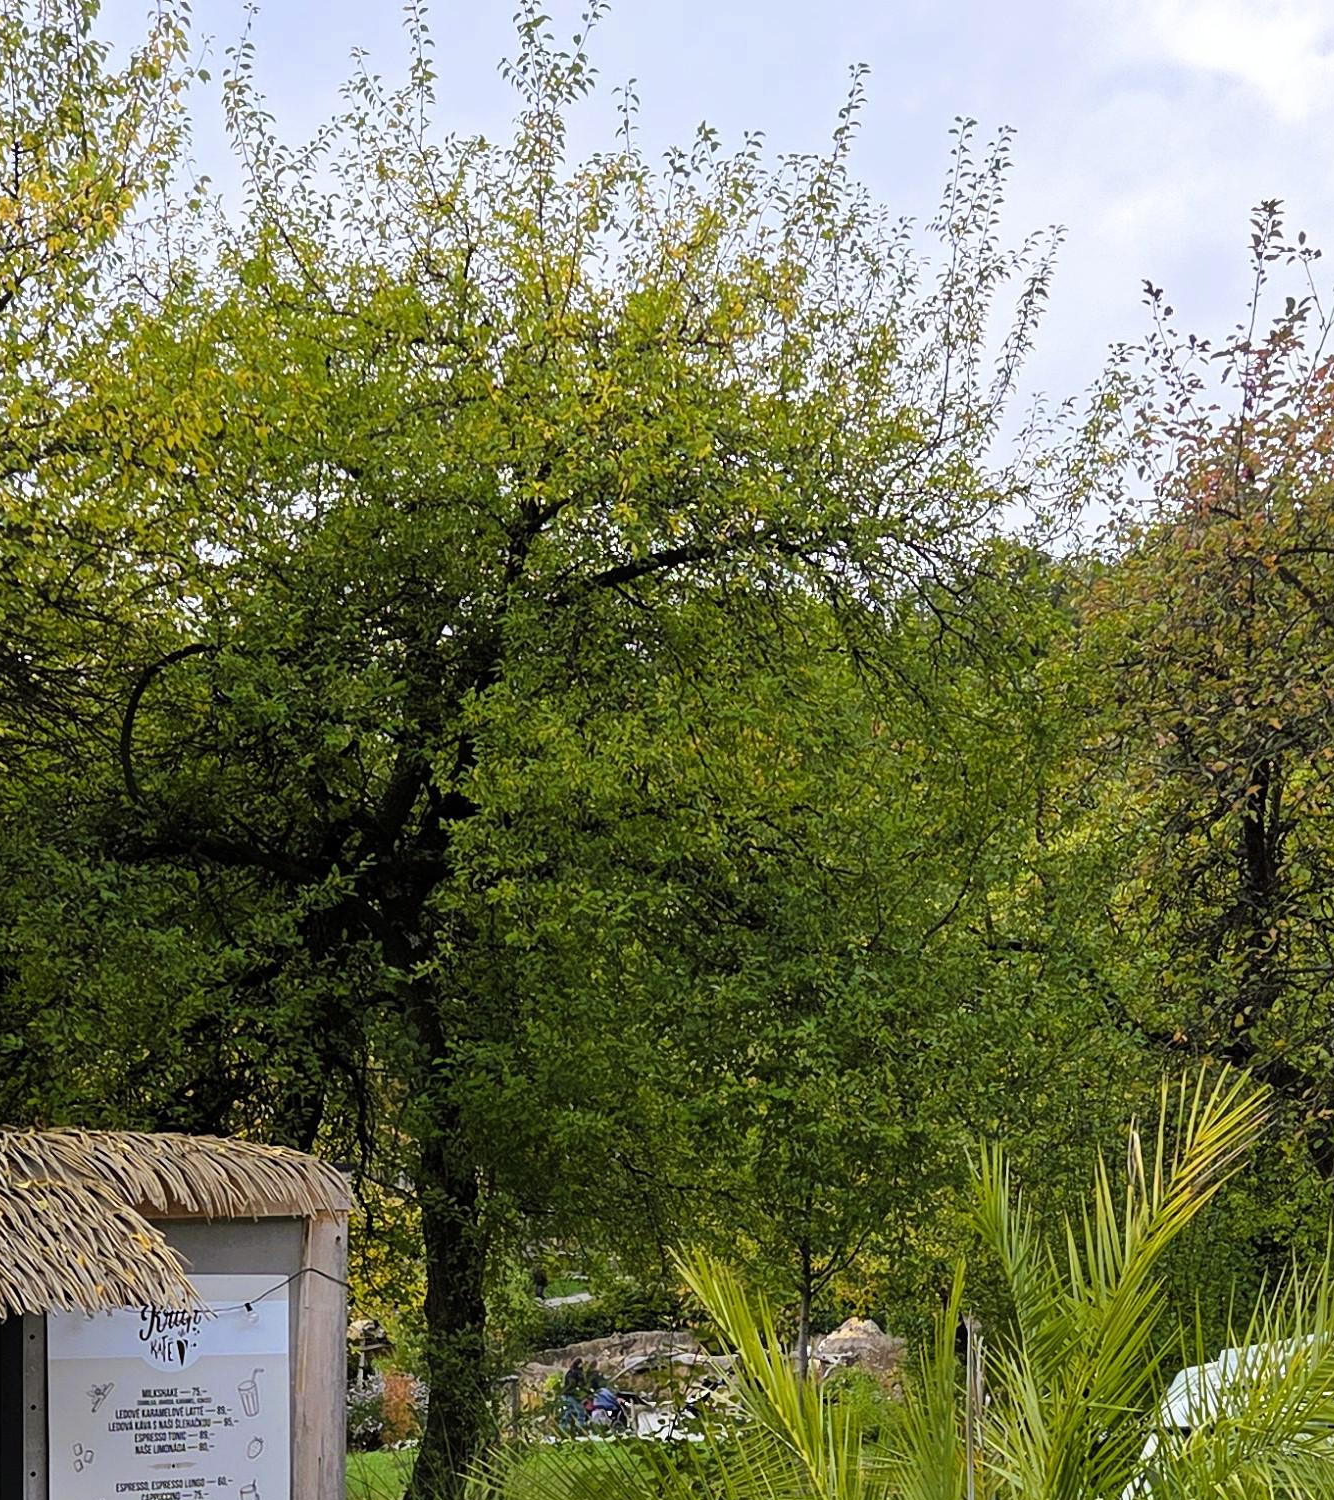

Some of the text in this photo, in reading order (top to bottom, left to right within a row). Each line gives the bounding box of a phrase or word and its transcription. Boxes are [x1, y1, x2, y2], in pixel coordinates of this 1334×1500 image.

[142, 1388, 178, 1398] MILKSHAKE
[116, 1408, 139, 1419] LEDOVÉ
[142, 1407, 183, 1417] KARAMELOVÉ
[108, 1421, 133, 1431] LEDOVÁ
[135, 1420, 152, 1430] KÁVA
[153, 1420, 157, 1429] S
[175, 1418, 211, 1428] ŠLEHAČKOU
[135, 1432, 166, 1442] ESPRESSO
[168, 1432, 186, 1440] TONIC
[135, 1444, 152, 1454] NAŠE
[154, 1443, 186, 1453] LIMONÁDA
[152, 1480, 183, 1490] ESPRESSO
[185, 1479, 204, 1488] LUNGO
